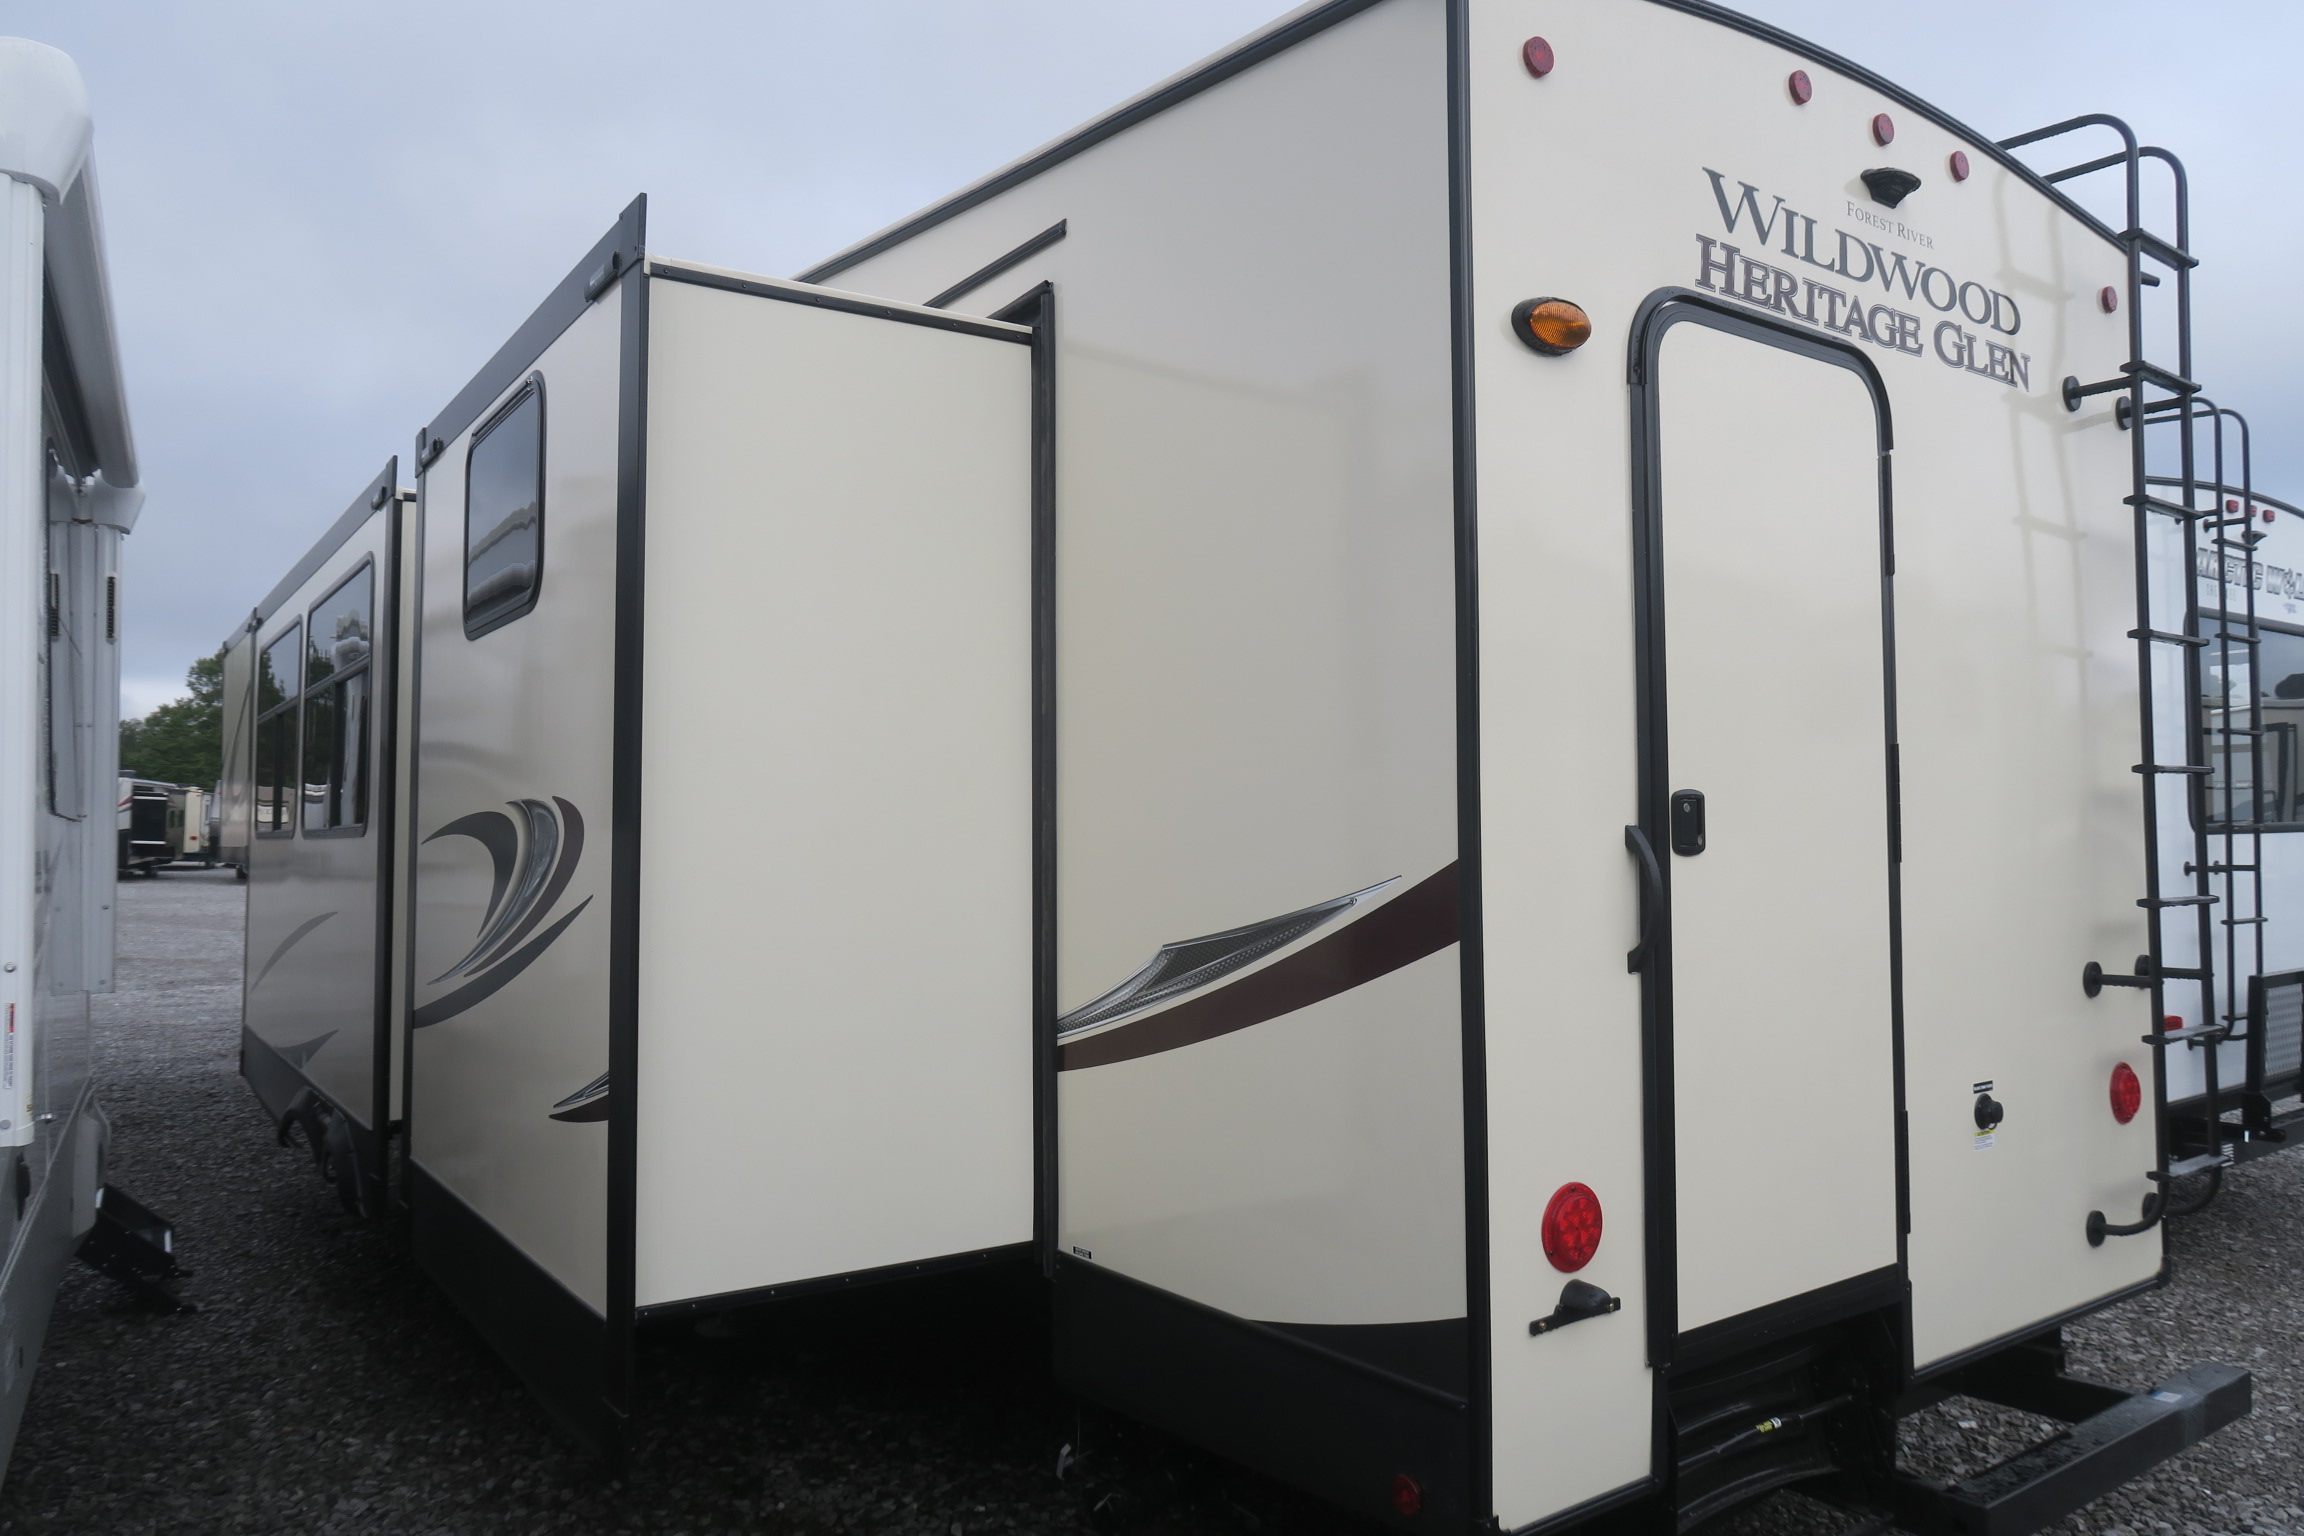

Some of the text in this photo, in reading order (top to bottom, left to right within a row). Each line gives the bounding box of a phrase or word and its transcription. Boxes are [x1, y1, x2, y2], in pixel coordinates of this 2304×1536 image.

[1701, 166, 2021, 336] WILDWOOD
[1846, 200, 1935, 250] FOREST RIVER
[1695, 233, 2031, 393] HERITAGE GLEN
